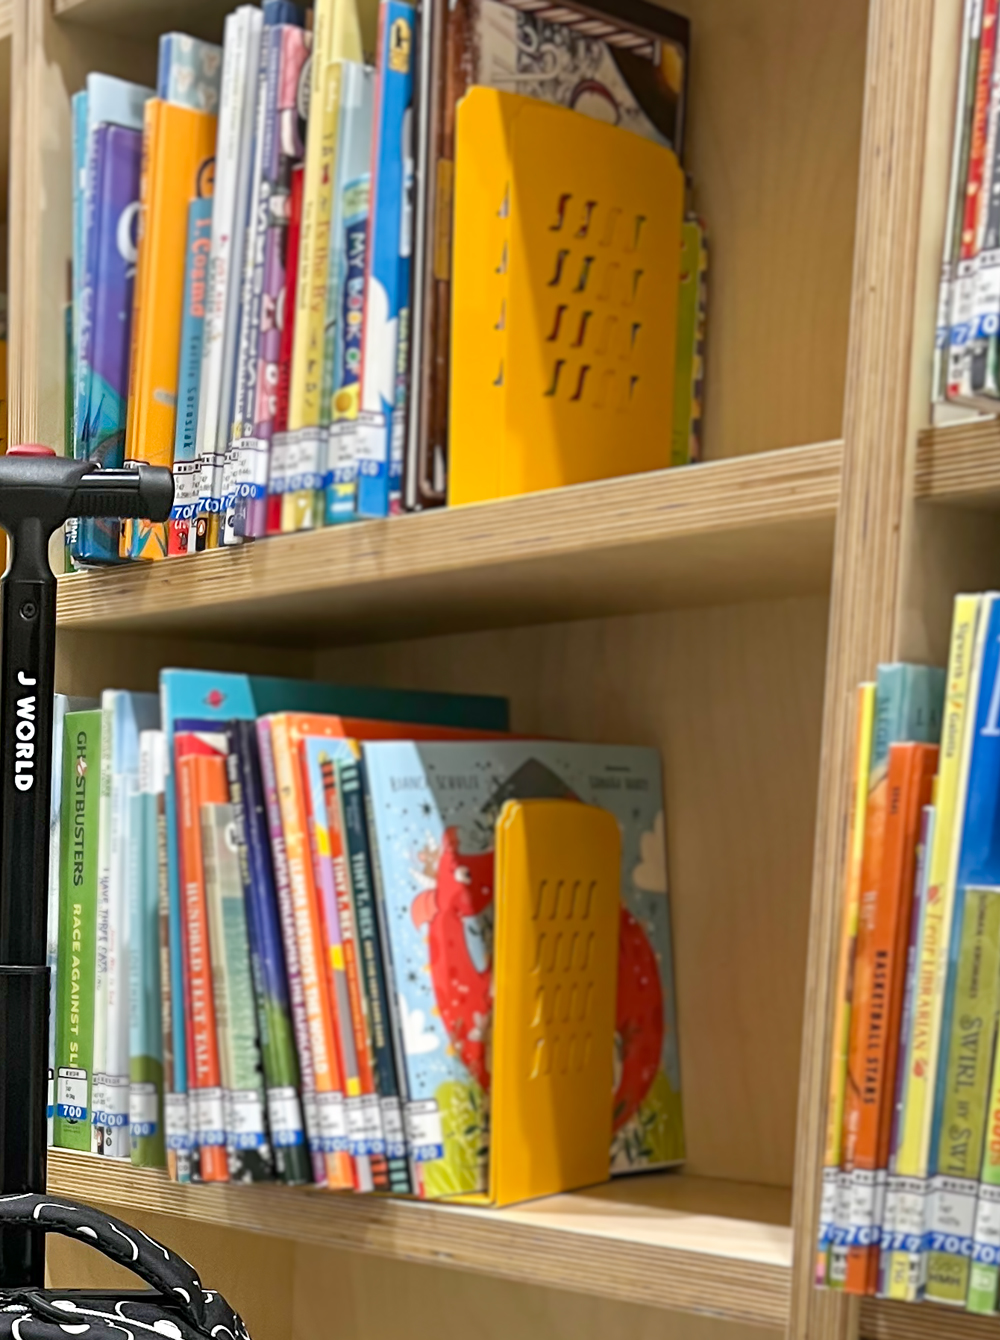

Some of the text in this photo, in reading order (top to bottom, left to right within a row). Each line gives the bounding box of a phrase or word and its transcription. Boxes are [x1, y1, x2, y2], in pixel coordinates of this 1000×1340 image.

[349, 233, 365, 268] MY
[190, 237, 211, 318] Cosmo
[346, 276, 363, 342] BOOK
[235, 484, 257, 498] 700
[14, 671, 36, 791] J WORLD
[102, 875, 110, 906] HAVE
[332, 856, 347, 890] TINY
[352, 852, 367, 890] TINY
[72, 903, 82, 951] RACE
[339, 911, 352, 940] REX
[359, 907, 374, 939] REX
[186, 882, 202, 972] HUNDRED
[195, 1030, 210, 1079] TALL
[289, 858, 329, 1074] LLAMA DESTROYS THE WORLD
[69, 955, 81, 1036] AGAINST
[867, 950, 888, 1051] BASKETBALL
[913, 959, 936, 1051] LIBRARIAN
[956, 1015, 982, 1092] SWIRL
[864, 1056, 878, 1104] STARS
[62, 1105, 83, 1119] 700
[948, 1124, 972, 1174] SWI
